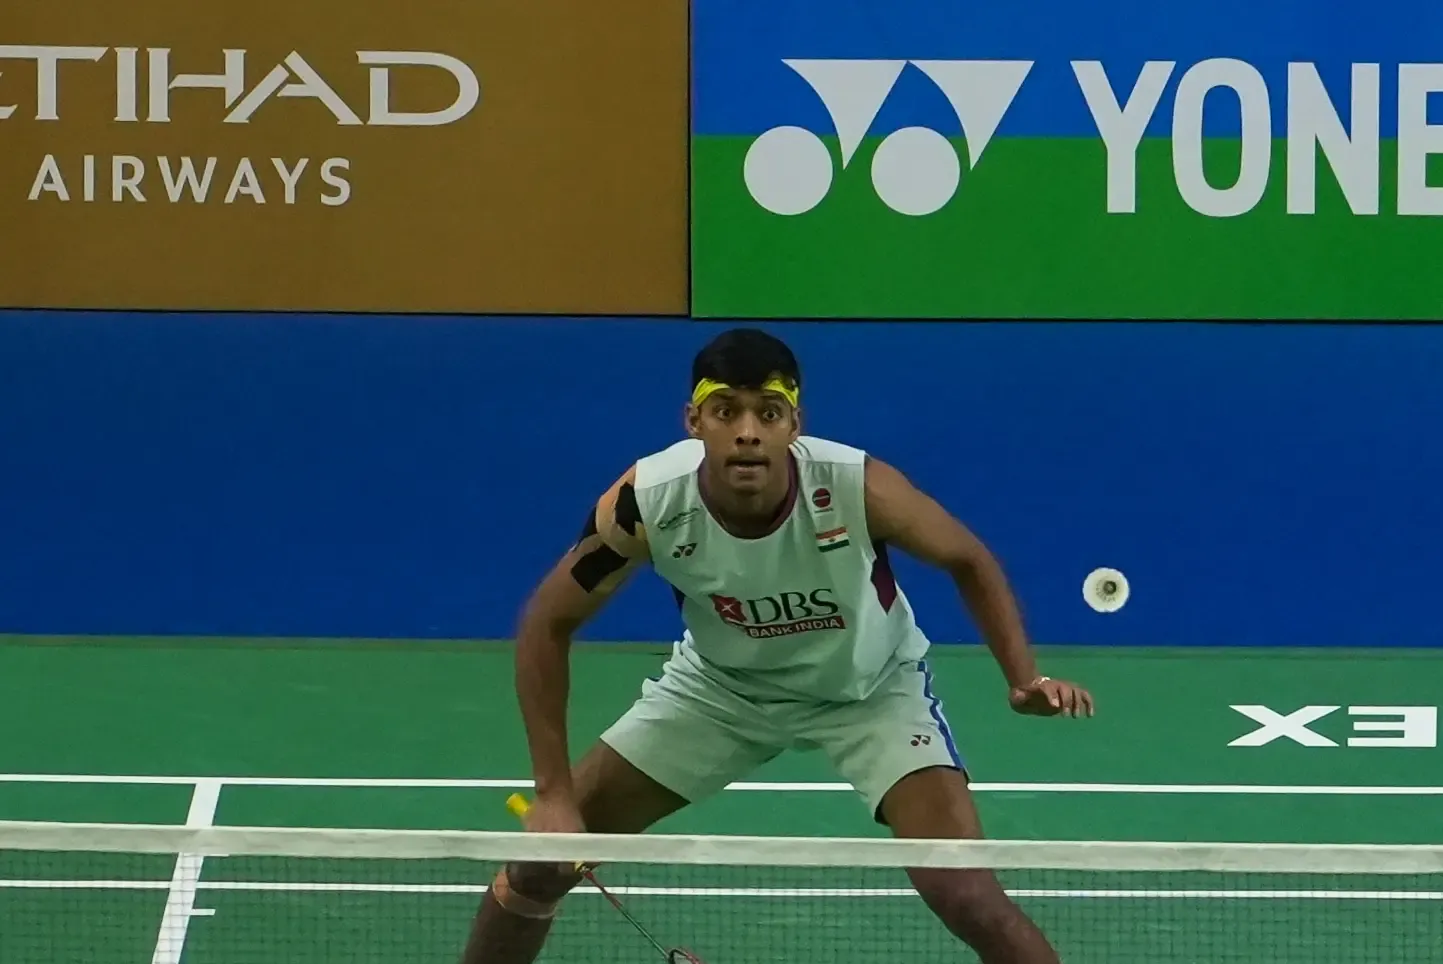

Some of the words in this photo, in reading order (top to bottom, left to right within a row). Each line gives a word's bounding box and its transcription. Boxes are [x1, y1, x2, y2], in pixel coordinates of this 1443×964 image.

[27, 153, 352, 206] AIRWAYS
[746, 588, 840, 624] DBS
[749, 625, 793, 637] BANK
[795, 618, 841, 633] INDIA
